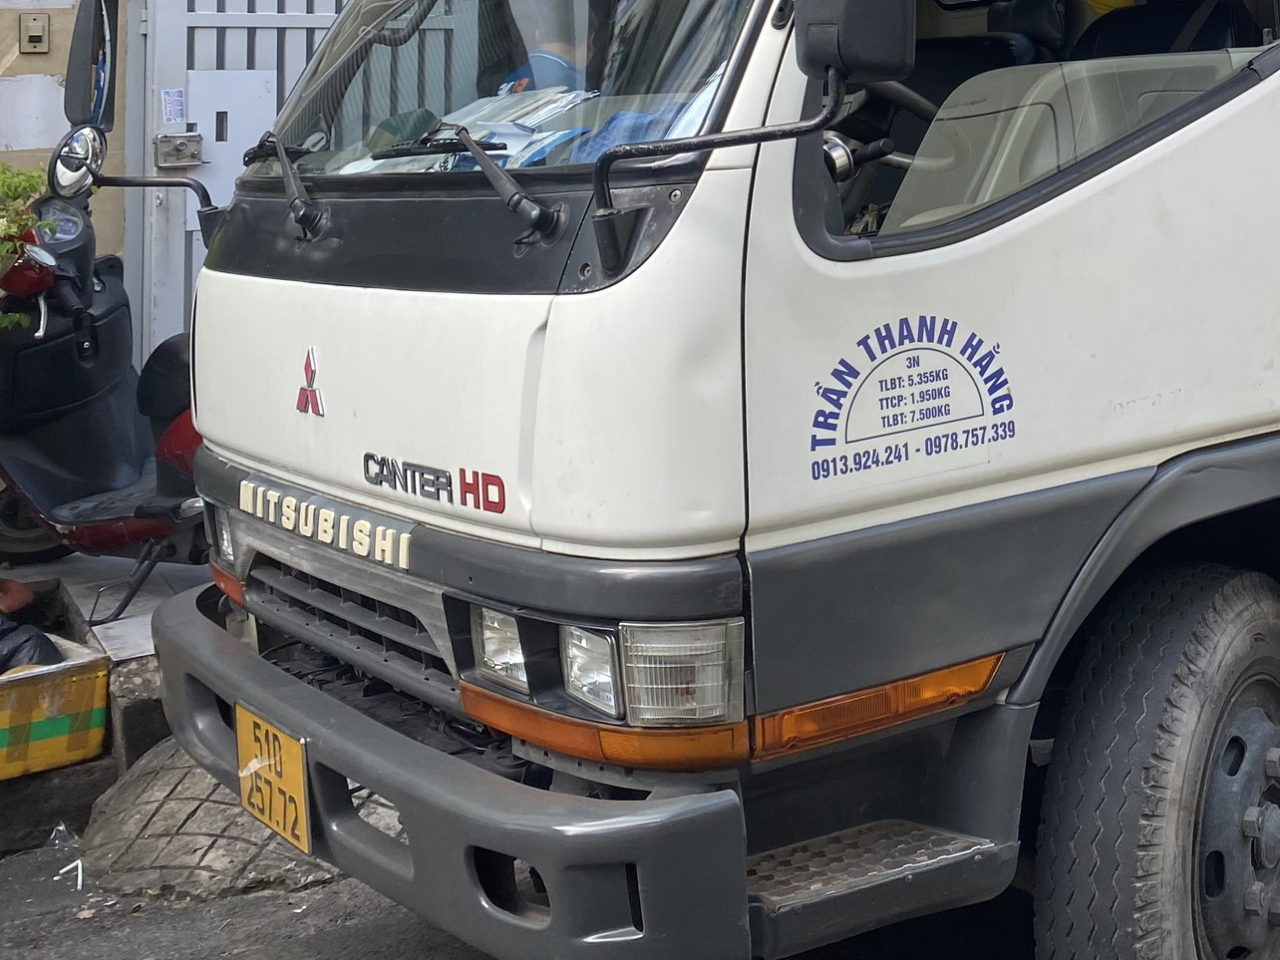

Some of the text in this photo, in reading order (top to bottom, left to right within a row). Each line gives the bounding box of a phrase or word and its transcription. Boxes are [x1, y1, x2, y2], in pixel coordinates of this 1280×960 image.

[809, 357, 861, 452] TRẦN
[855, 315, 958, 363] THANH
[878, 368, 949, 393] TLBT: 5.355KG
[905, 355, 920, 369] 3N
[878, 385, 951, 411] TTCP: 1.950KG
[881, 403, 951, 428] TLBT: 7.500KG
[811, 442, 909, 481] 0913.924.241
[925, 420, 1016, 456] 0978.757.339
[363, 451, 506, 514] CANTER HD
[239, 479, 412, 570] MITSUBISHI
[252, 720, 283, 779] 51D
[247, 768, 300, 842] 257.72
